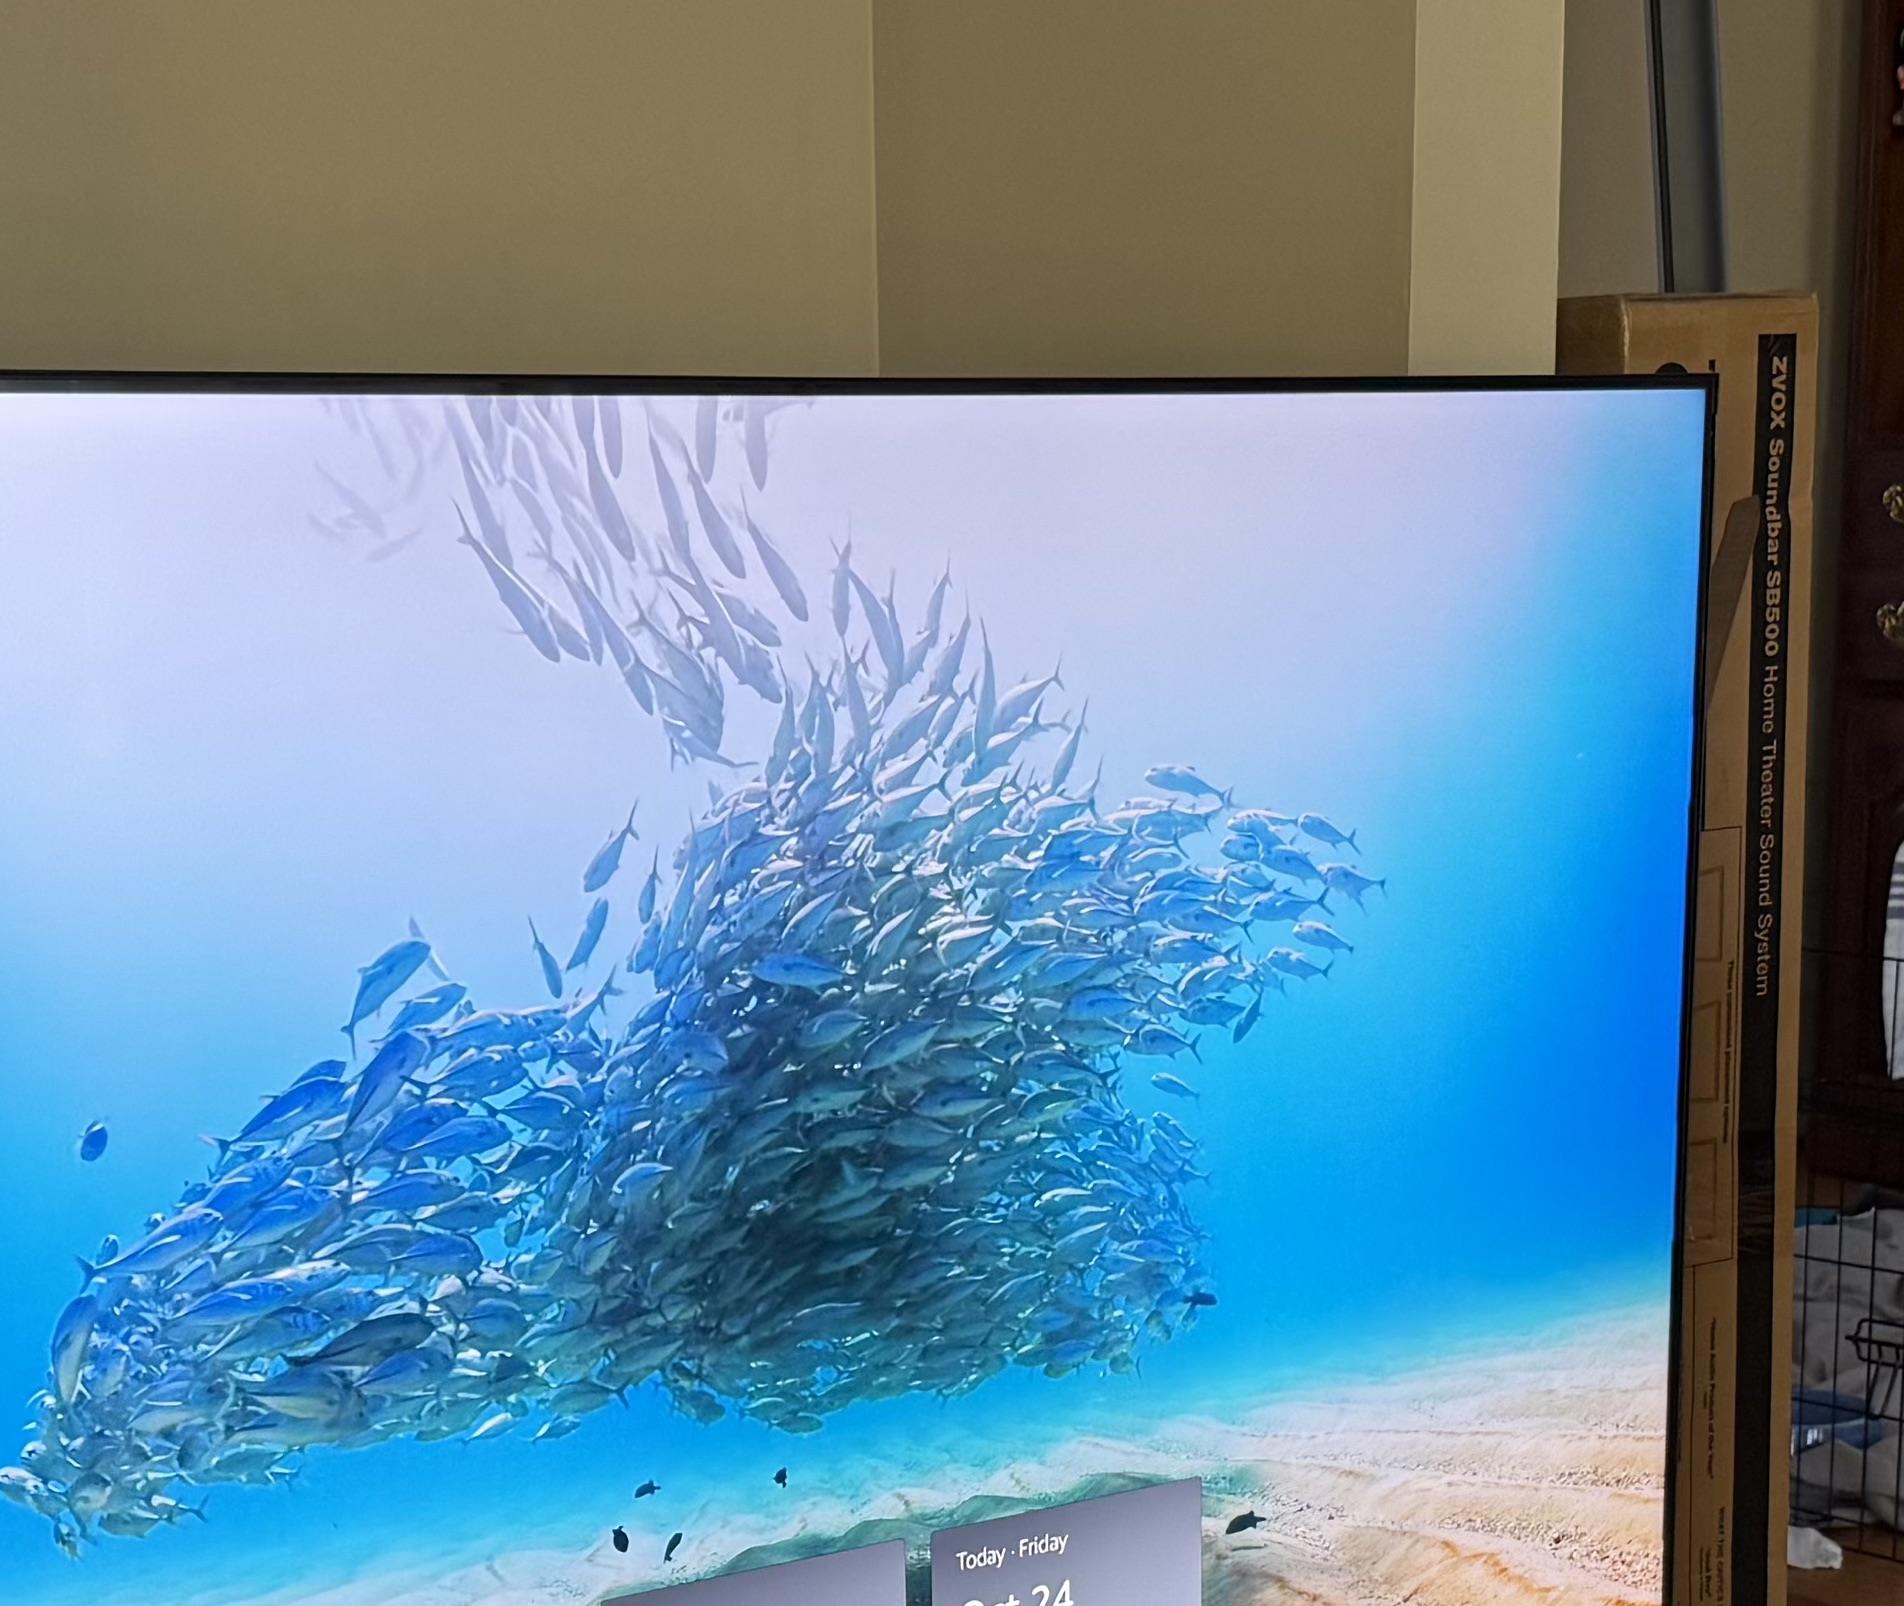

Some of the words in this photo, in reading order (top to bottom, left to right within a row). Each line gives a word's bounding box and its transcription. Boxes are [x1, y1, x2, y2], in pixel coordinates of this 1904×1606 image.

[1769, 355, 1788, 429] ZVOX
[1765, 437, 1785, 567] Soundbar
[1763, 569, 1782, 657] SB500
[1761, 664, 1779, 734] Home
[1760, 740, 1778, 829] Theater
[1757, 834, 1775, 907] Sound
[1754, 912, 1774, 997] System
[956, 1546, 1006, 1571] Today
[1019, 1533, 1069, 1558] Friday
